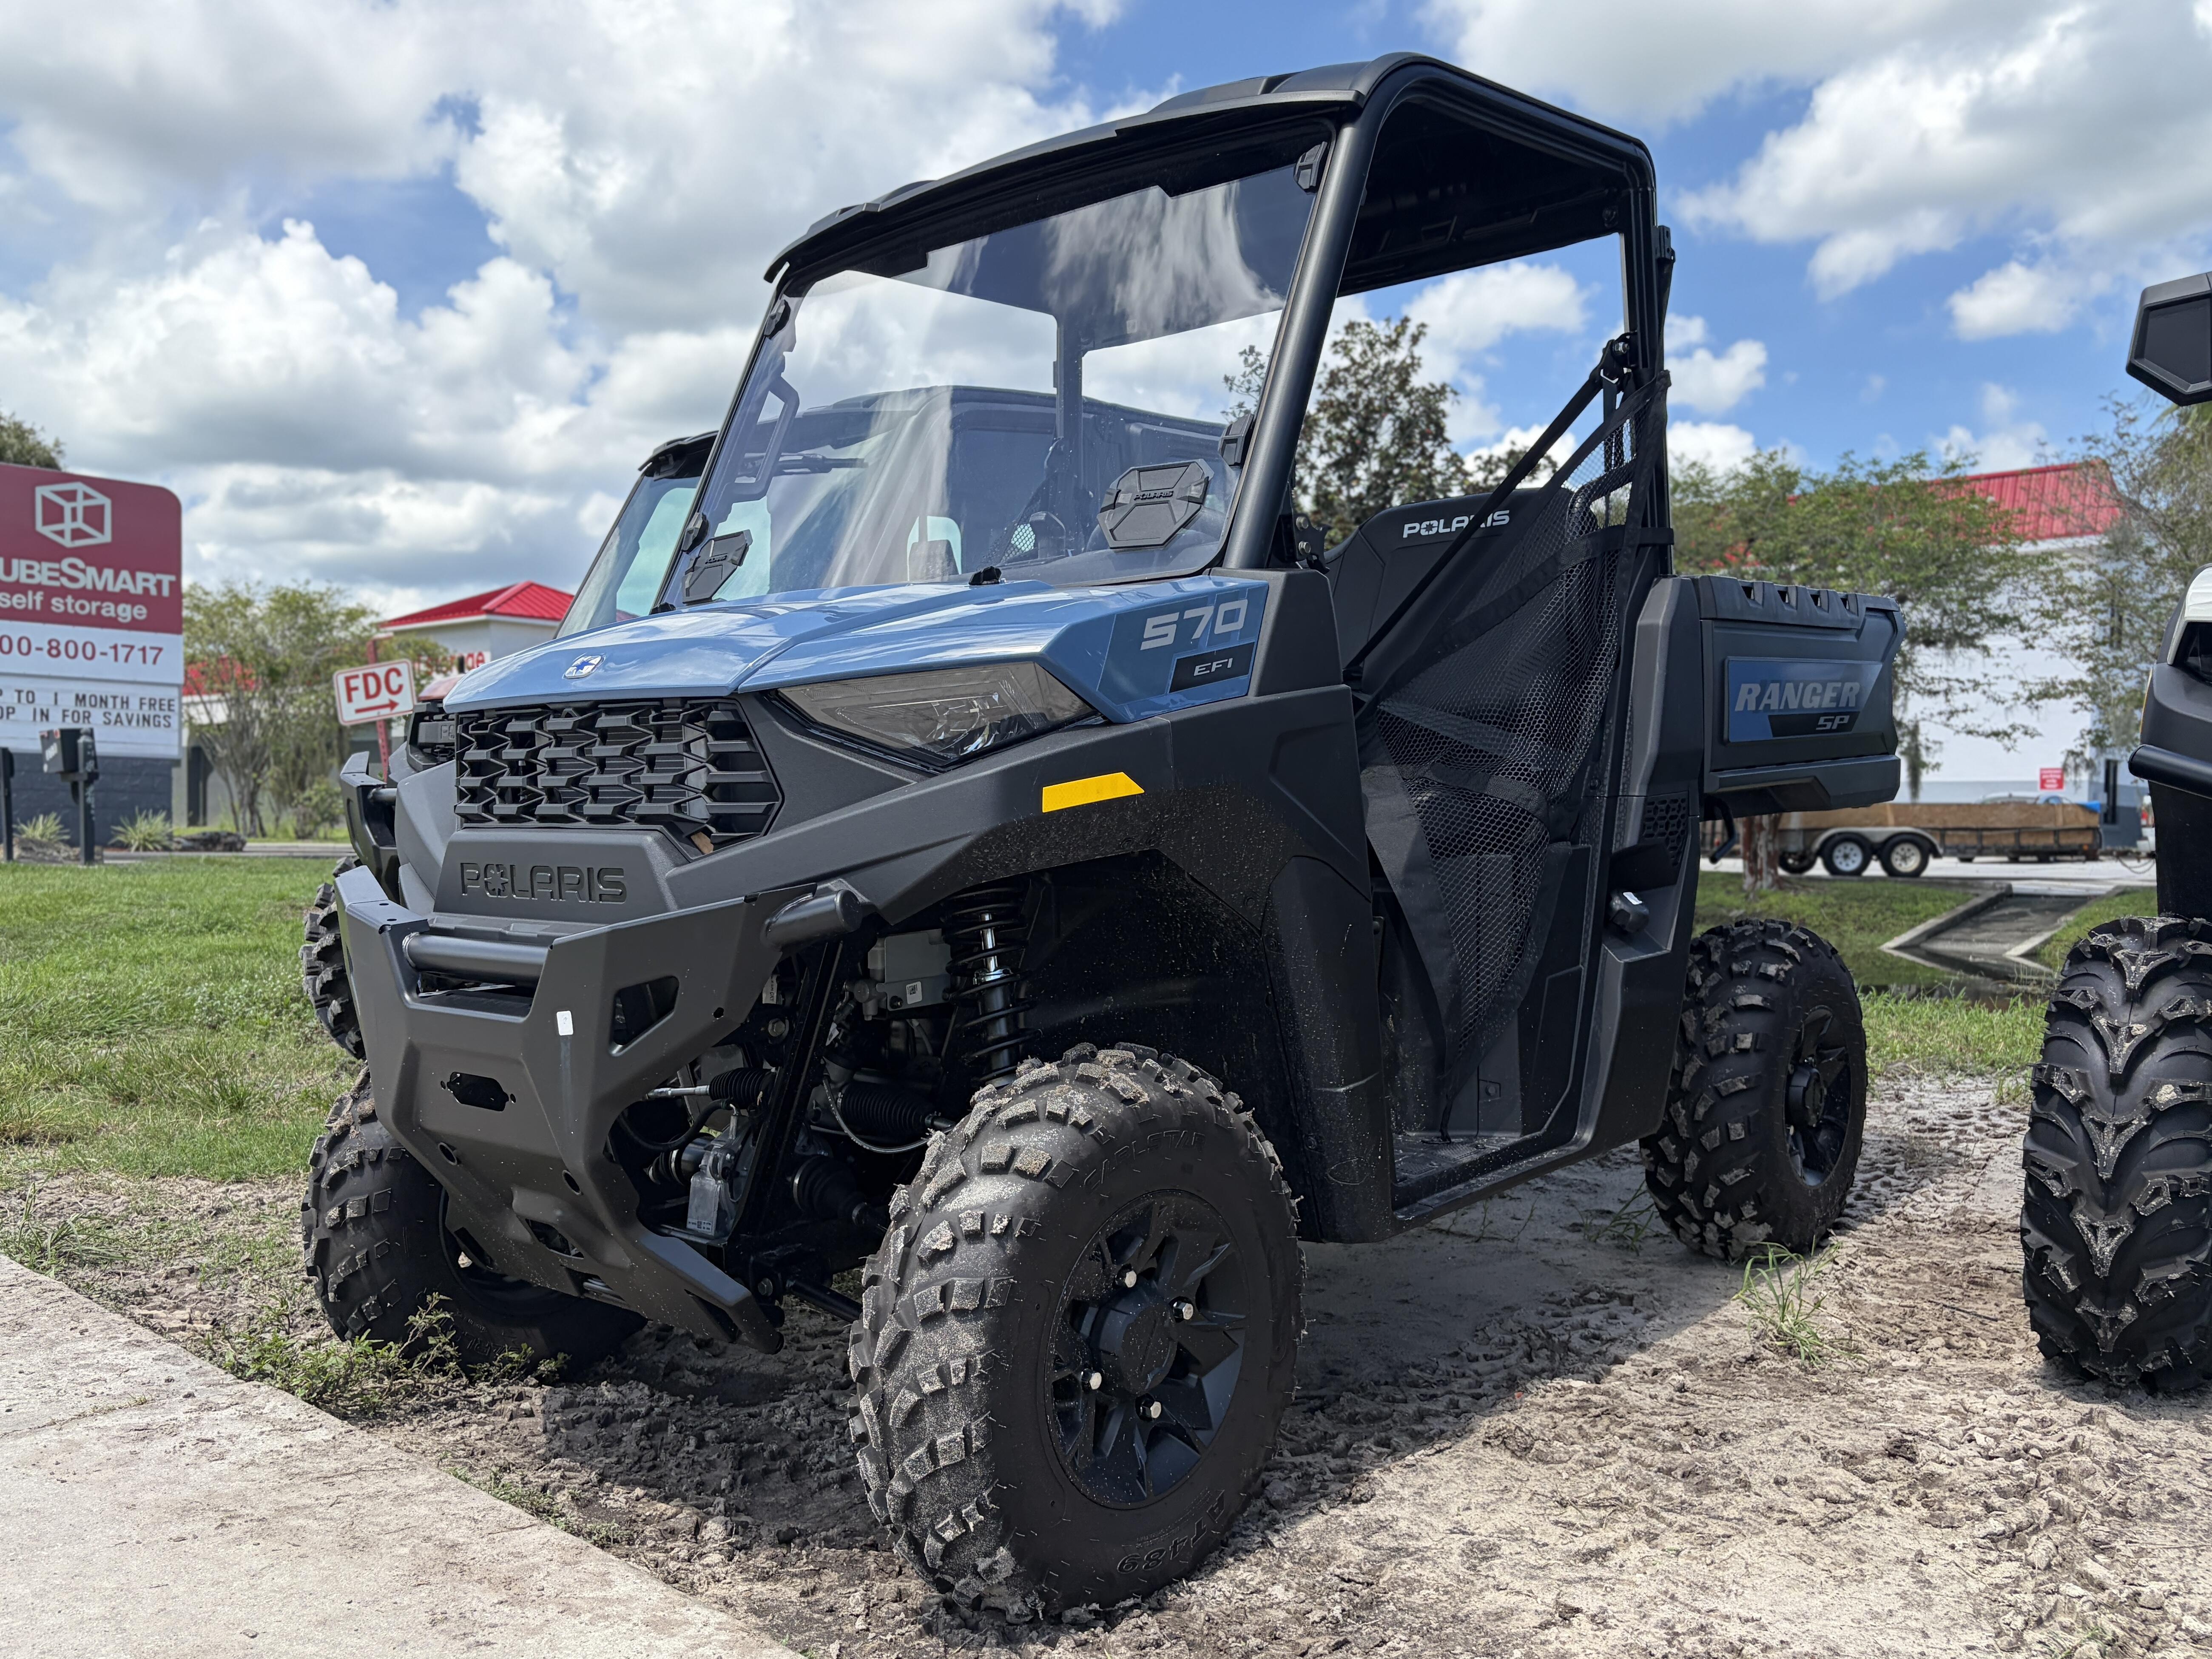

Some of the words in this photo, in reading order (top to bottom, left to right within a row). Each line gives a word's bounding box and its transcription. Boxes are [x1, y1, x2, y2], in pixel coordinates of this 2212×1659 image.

[1134, 490, 1174, 501] POLARIS
[1403, 510, 1510, 538] POLAIS
[0, 590, 44, 611] self
[51, 594, 148, 623] storage
[1140, 599, 1248, 651] 570
[0, 634, 164, 665] 00-800-1717
[1193, 658, 1233, 676] EFI
[344, 667, 404, 703] FDC
[1734, 682, 1861, 712] RANGER
[15, 689, 35, 704] TO
[75, 693, 129, 710] MONTH
[139, 697, 175, 712] FREE
[33, 707, 49, 722] IN
[62, 709, 91, 724] FOR
[102, 711, 171, 728] SAVINGS
[1815, 715, 1850, 731] SP
[460, 863, 627, 904] POLARIS
[1083, 1129, 1208, 1191] CARLSTAR
[1117, 1489, 1225, 1575] AT489
